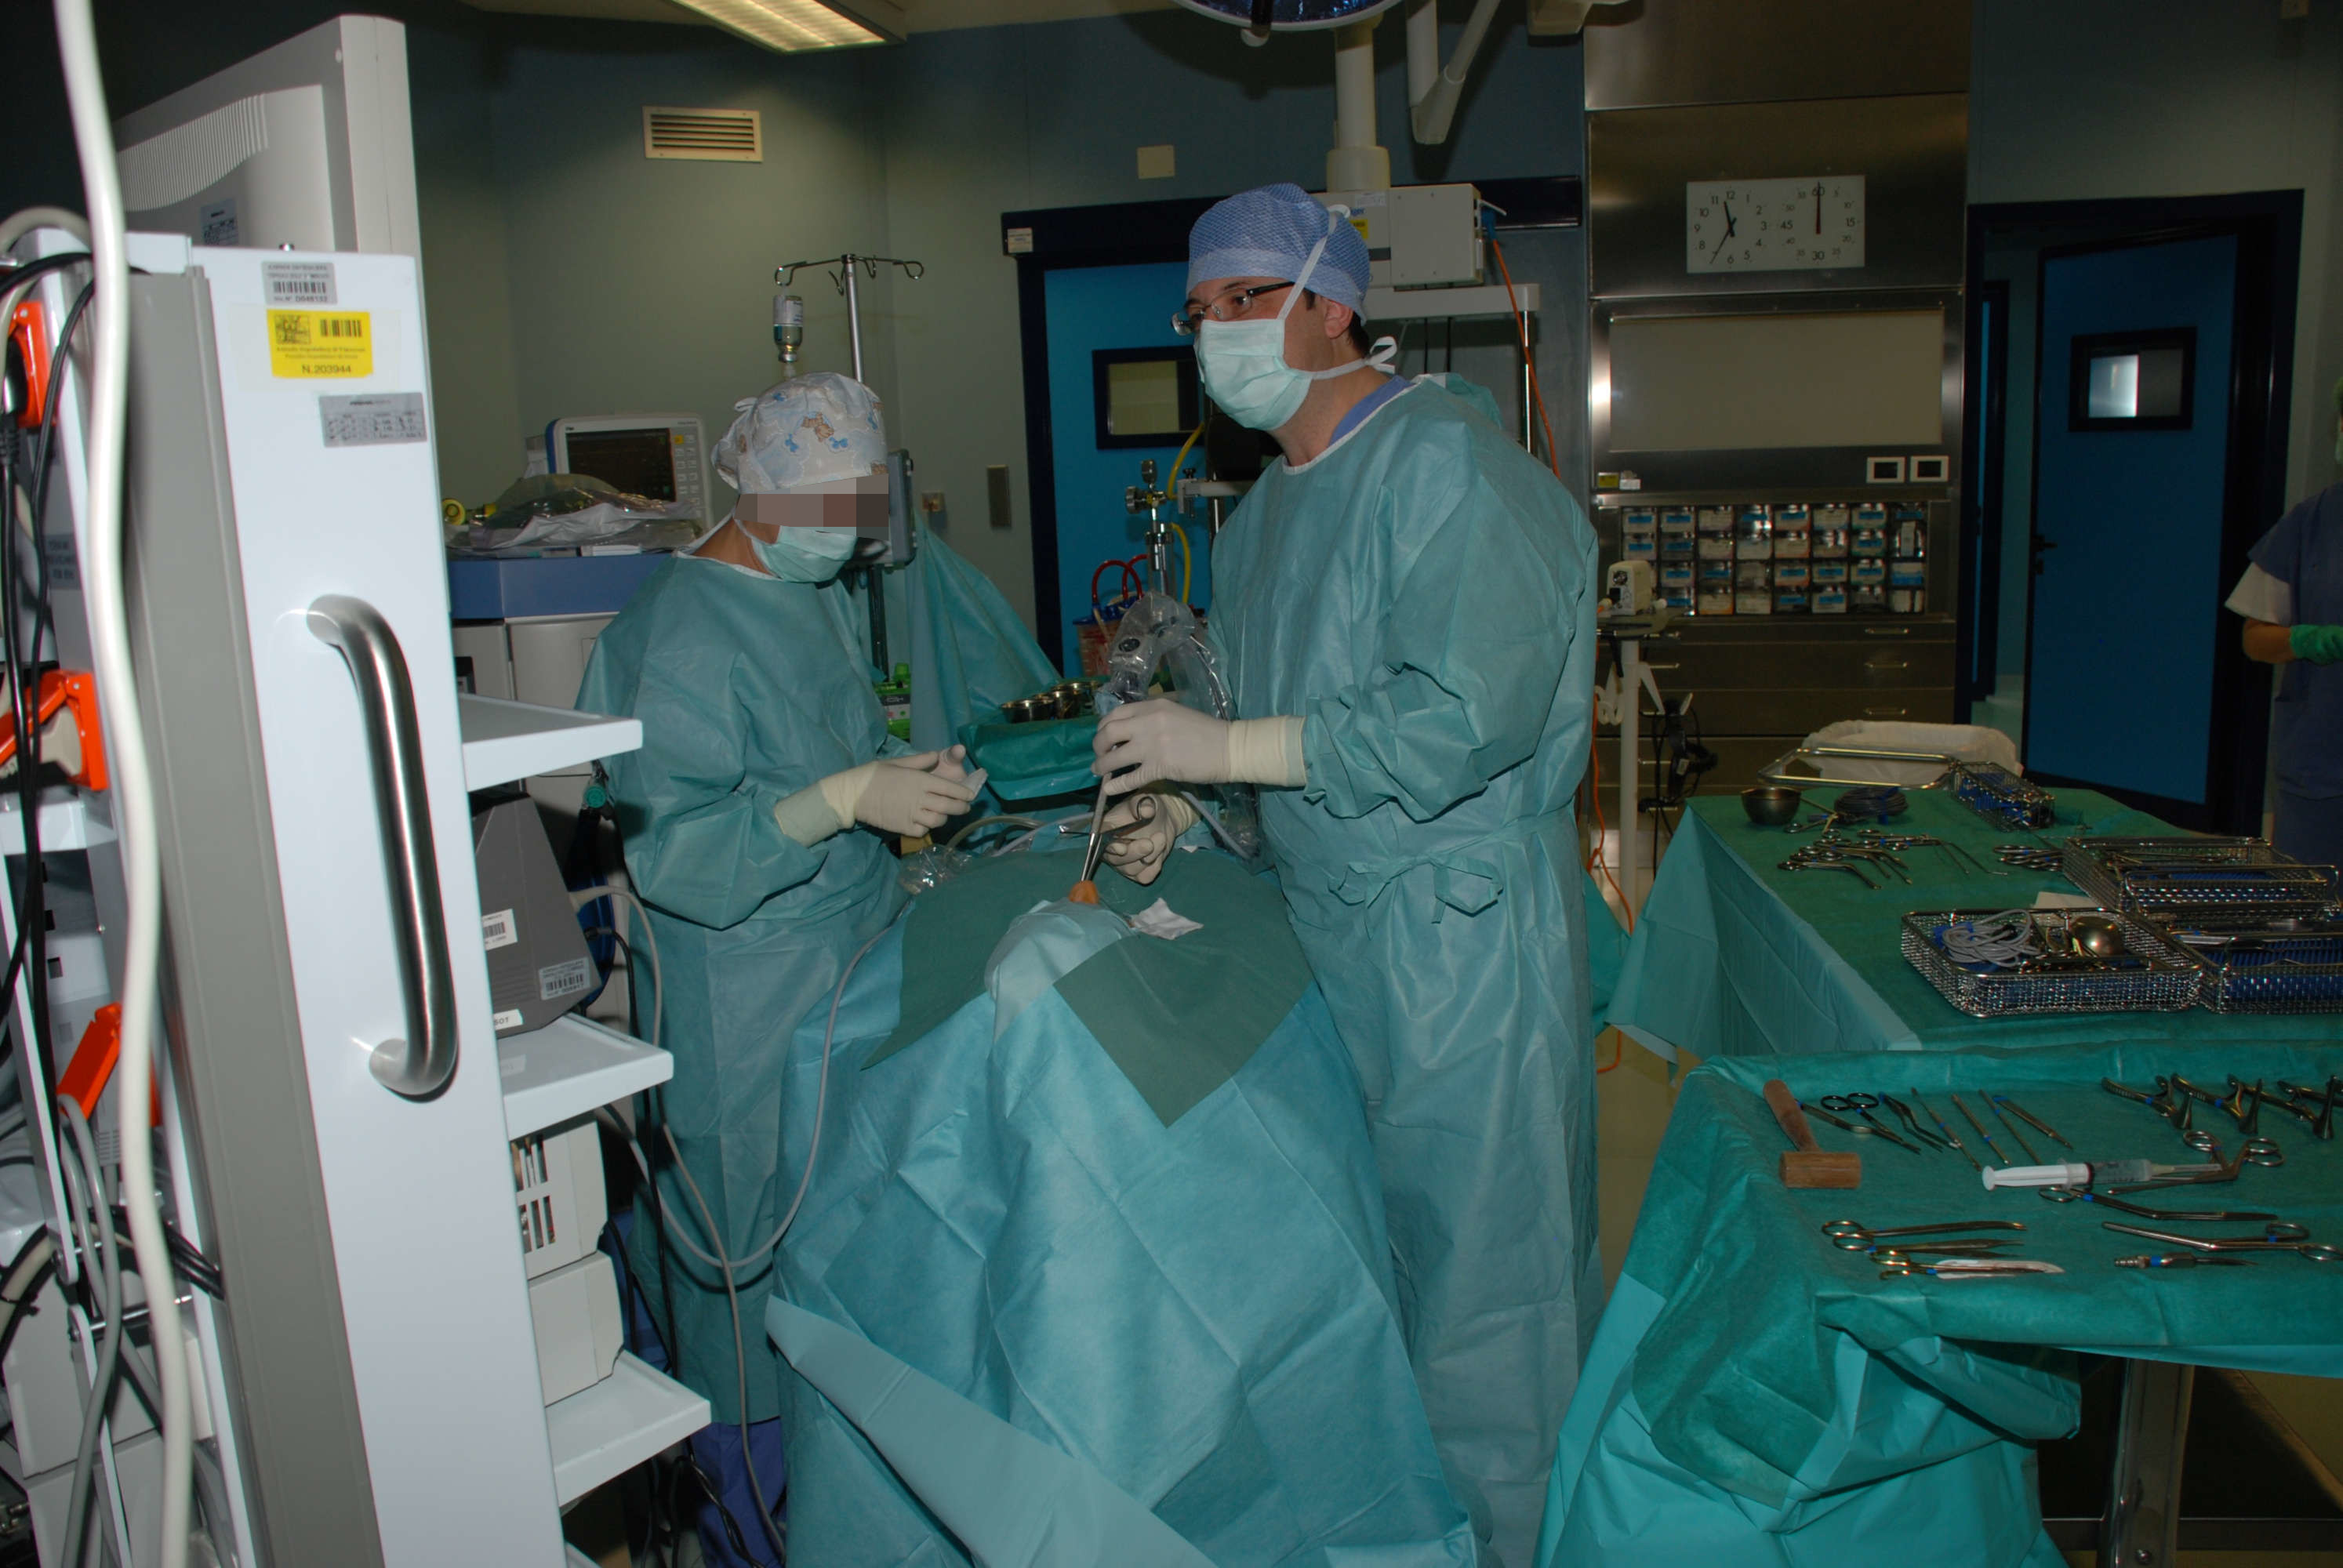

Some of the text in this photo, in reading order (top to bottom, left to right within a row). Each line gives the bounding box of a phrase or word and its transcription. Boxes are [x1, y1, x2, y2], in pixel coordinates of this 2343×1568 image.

[1711, 195, 1718, 205] 11
[1726, 191, 1735, 200] 12
[1745, 194, 1750, 204] 1
[1699, 208, 1709, 217] 10
[1756, 205, 1762, 216] 2
[1760, 220, 1767, 231] 3
[1780, 220, 1793, 230] 45
[1846, 217, 1854, 227] 15
[1694, 223, 1700, 233] 9
[1698, 240, 1705, 250] 8
[1756, 238, 1761, 247] 4
[1727, 255, 1734, 264] 6
[1743, 250, 1750, 260] 5
[1812, 250, 1825, 261] 30
